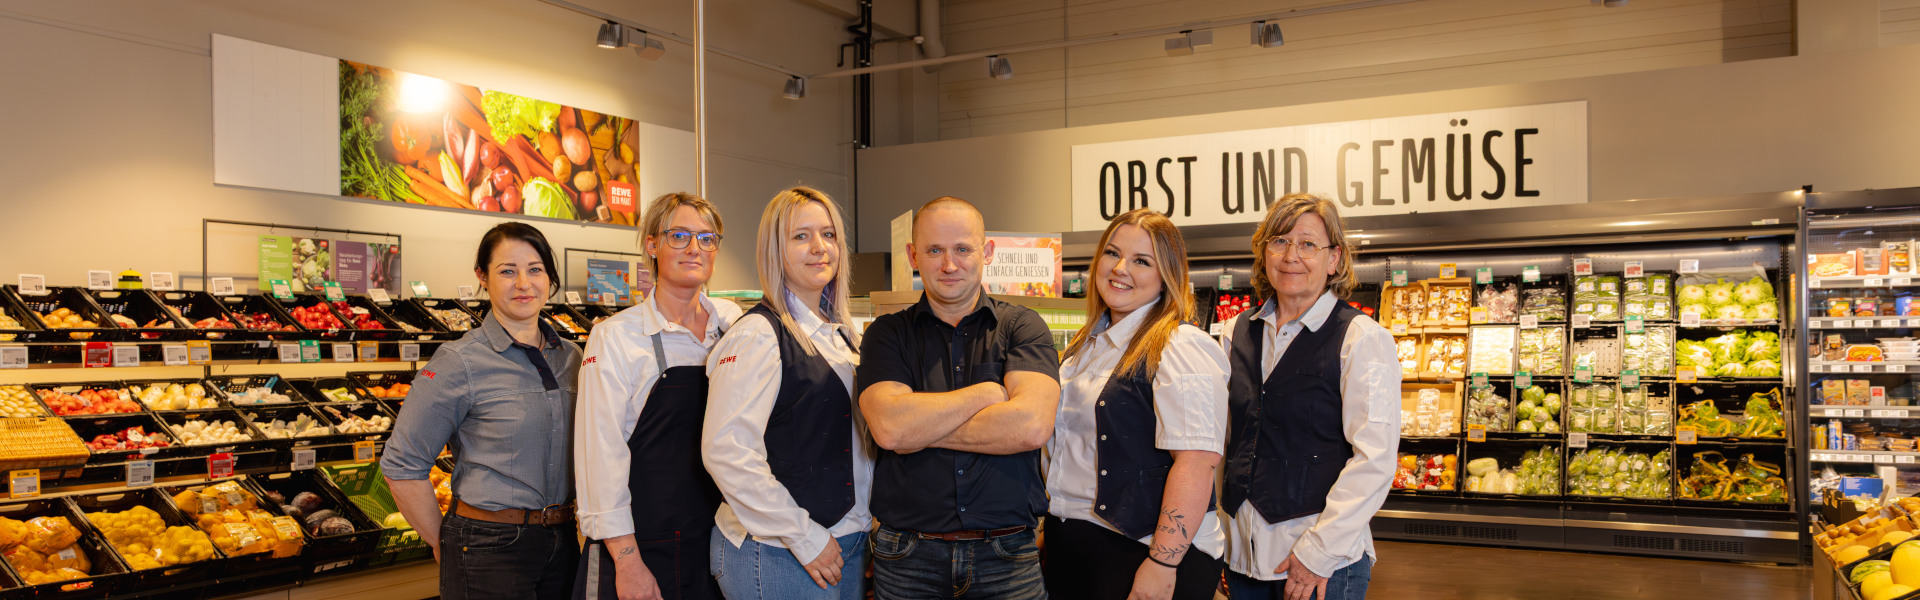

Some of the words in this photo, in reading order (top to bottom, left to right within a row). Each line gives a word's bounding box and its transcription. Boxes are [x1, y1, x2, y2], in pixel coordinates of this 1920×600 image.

[1099, 156, 1197, 221] OBST
[1222, 147, 1308, 214] UND
[1336, 118, 1540, 208] GEMÜSE
[611, 186, 631, 198] REWE
[997, 252, 1023, 264] SCHNELL
[1025, 252, 1038, 264] UND
[986, 265, 1014, 277] EINFACH
[1015, 265, 1049, 277] GENIESSEN
